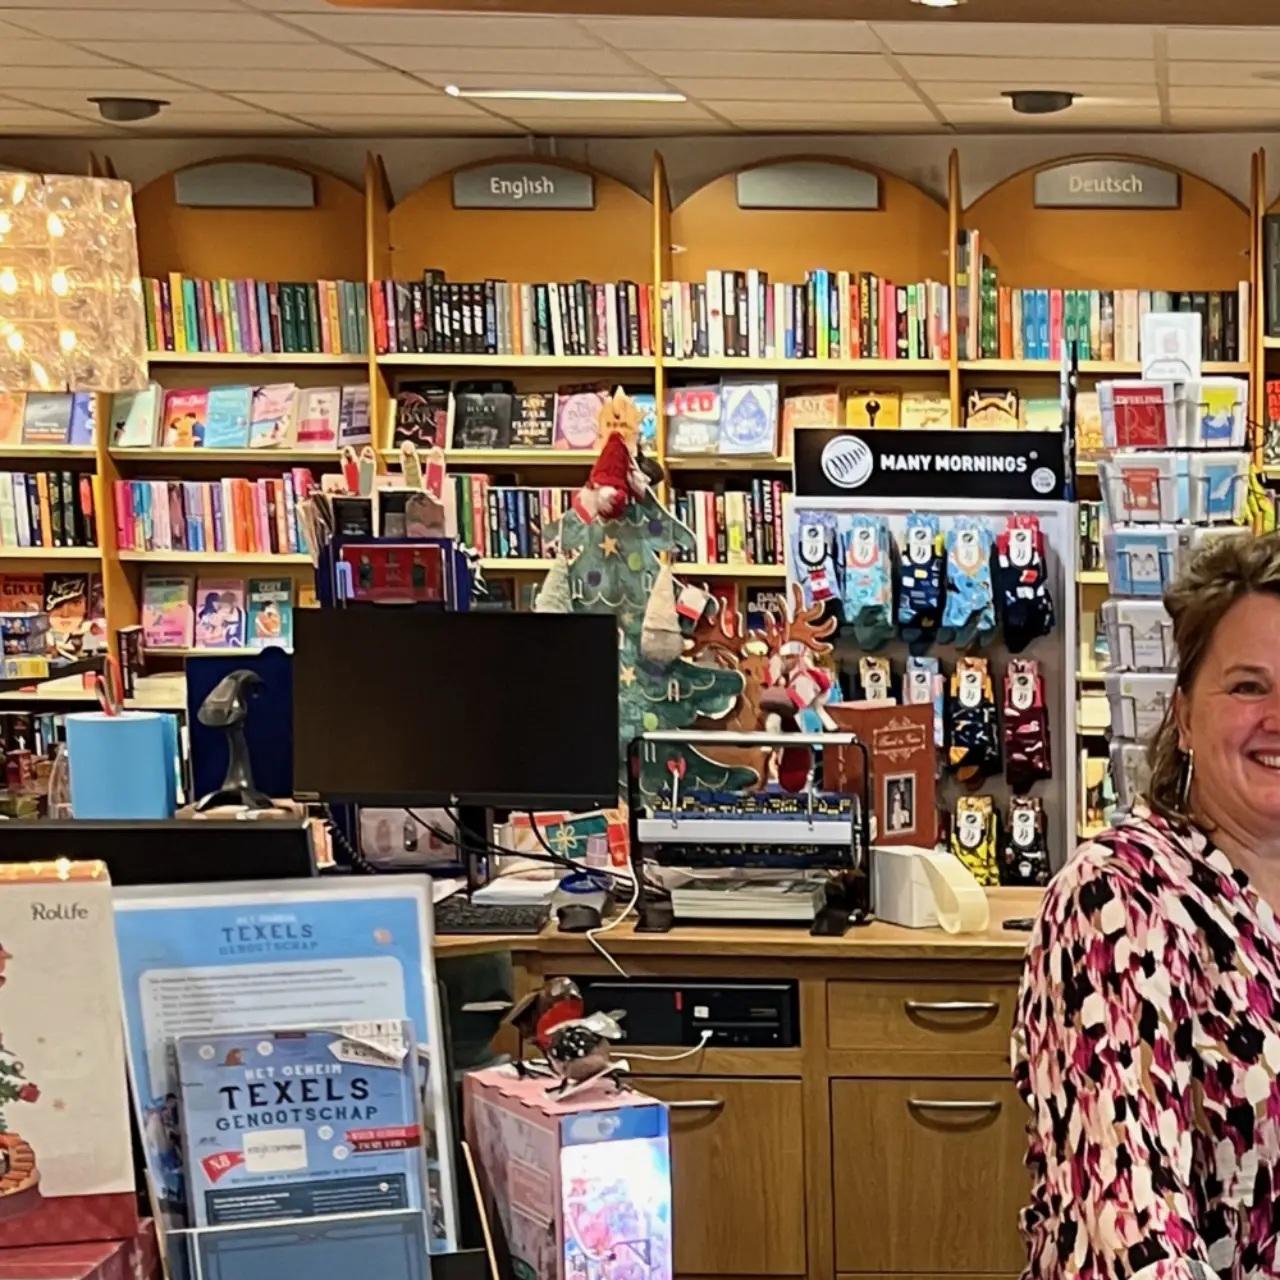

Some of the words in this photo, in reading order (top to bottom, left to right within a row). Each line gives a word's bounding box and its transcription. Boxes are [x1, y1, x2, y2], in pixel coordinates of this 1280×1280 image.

[490, 176, 554, 198] English
[1068, 174, 1143, 194] Deutsch
[880, 455, 932, 471] MANY
[935, 456, 1027, 472] MORNINGS
[31, 902, 89, 922] Rolife
[222, 924, 314, 942] TEXELS
[244, 1068, 276, 1079] HET
[219, 1078, 369, 1109] TEXELS
[216, 1106, 378, 1130] GENOOTSCHAP
